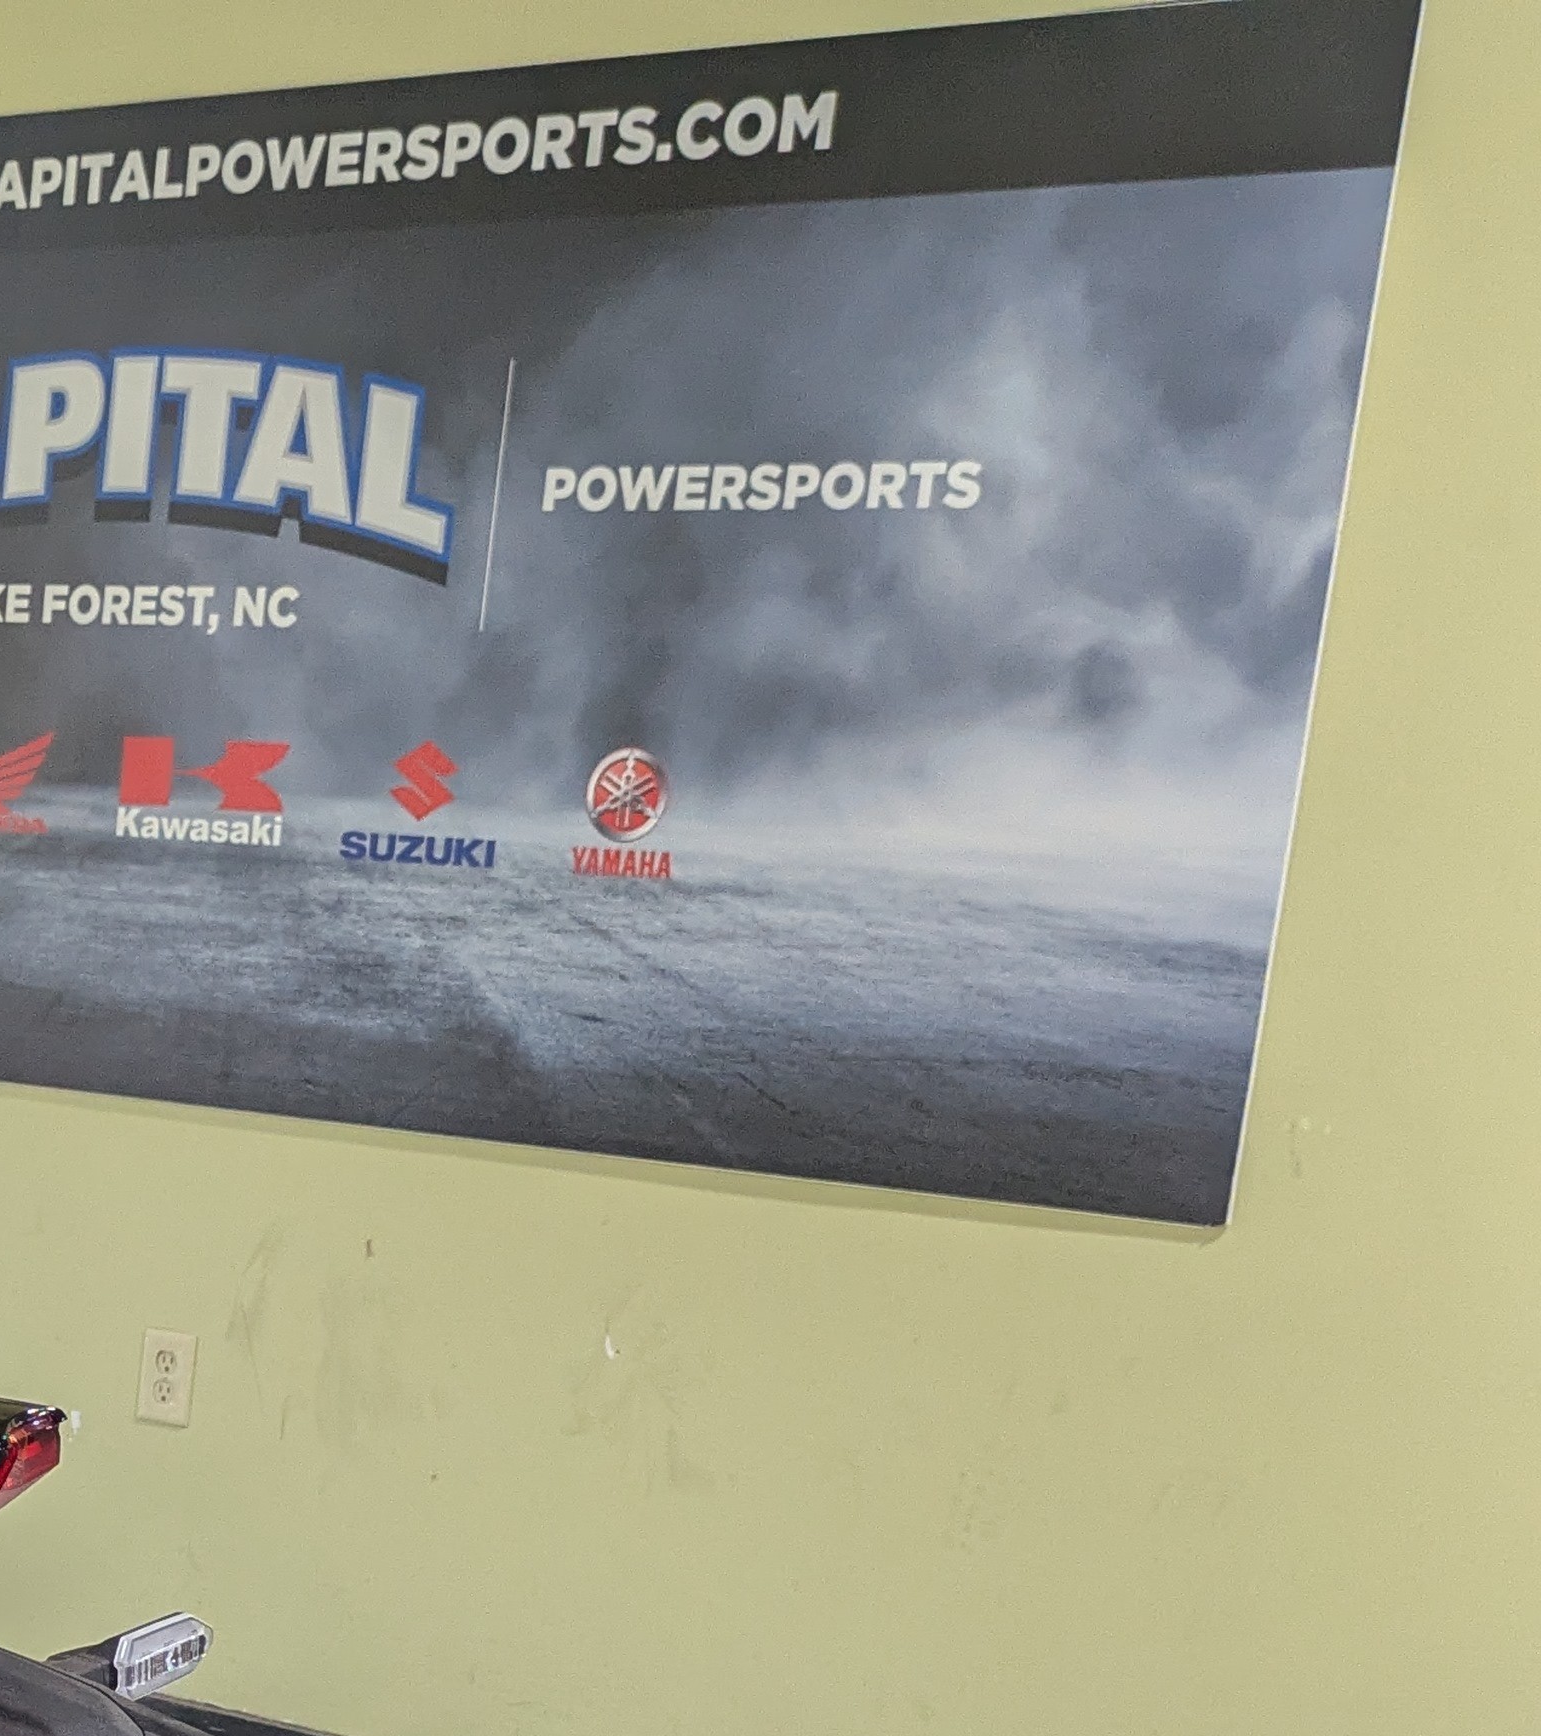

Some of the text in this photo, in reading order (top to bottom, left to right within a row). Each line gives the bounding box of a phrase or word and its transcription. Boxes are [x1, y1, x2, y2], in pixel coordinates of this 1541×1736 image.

[541, 460, 984, 513] POWERSPORTS
[41, 583, 220, 635] FOREST,
[232, 586, 301, 629] NC
[115, 806, 284, 847] Kawasaki
[340, 830, 497, 869] SUZUKI
[572, 846, 671, 878] YAMAHA
